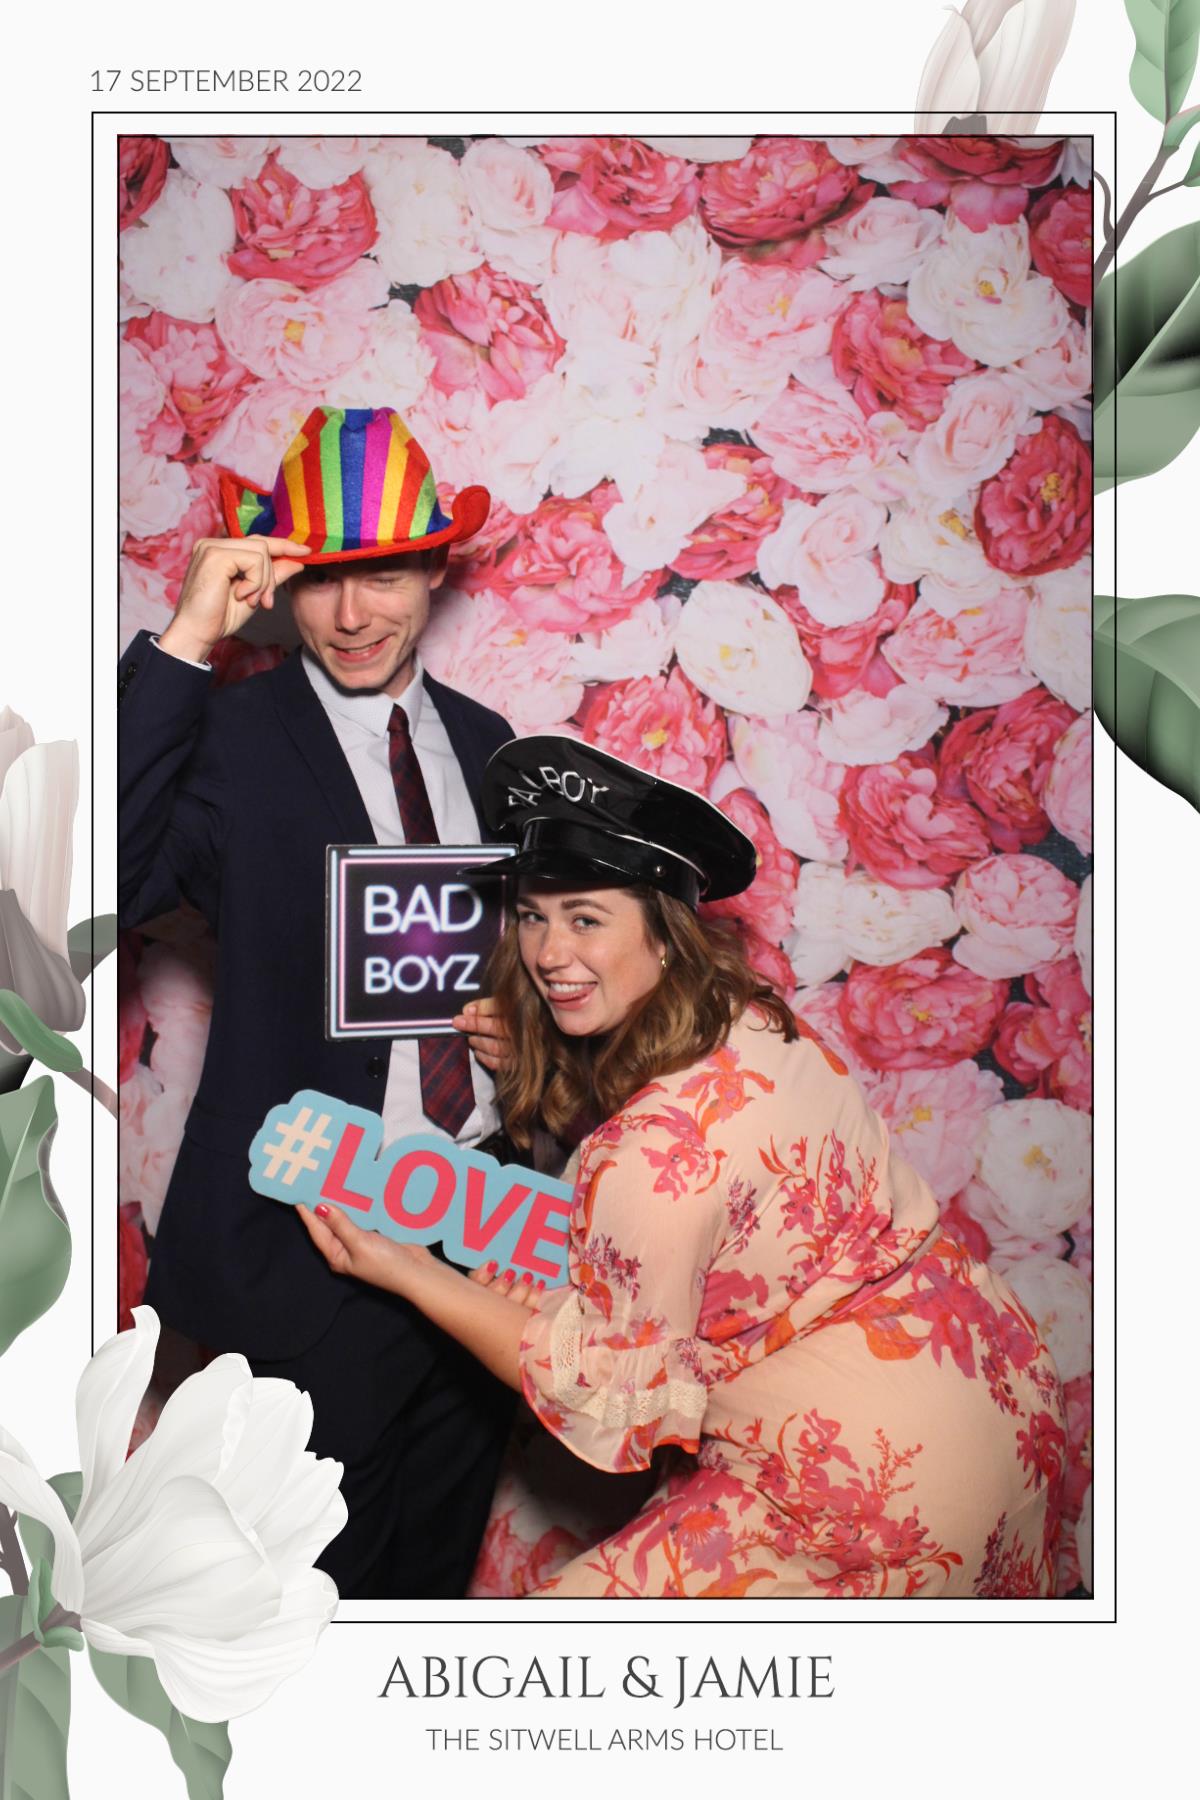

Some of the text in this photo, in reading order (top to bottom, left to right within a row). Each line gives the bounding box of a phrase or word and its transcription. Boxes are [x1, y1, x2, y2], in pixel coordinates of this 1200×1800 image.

[364, 884, 483, 935] BAD
[364, 953, 481, 994] BOYZ
[262, 1106, 572, 1279] #LOVE
